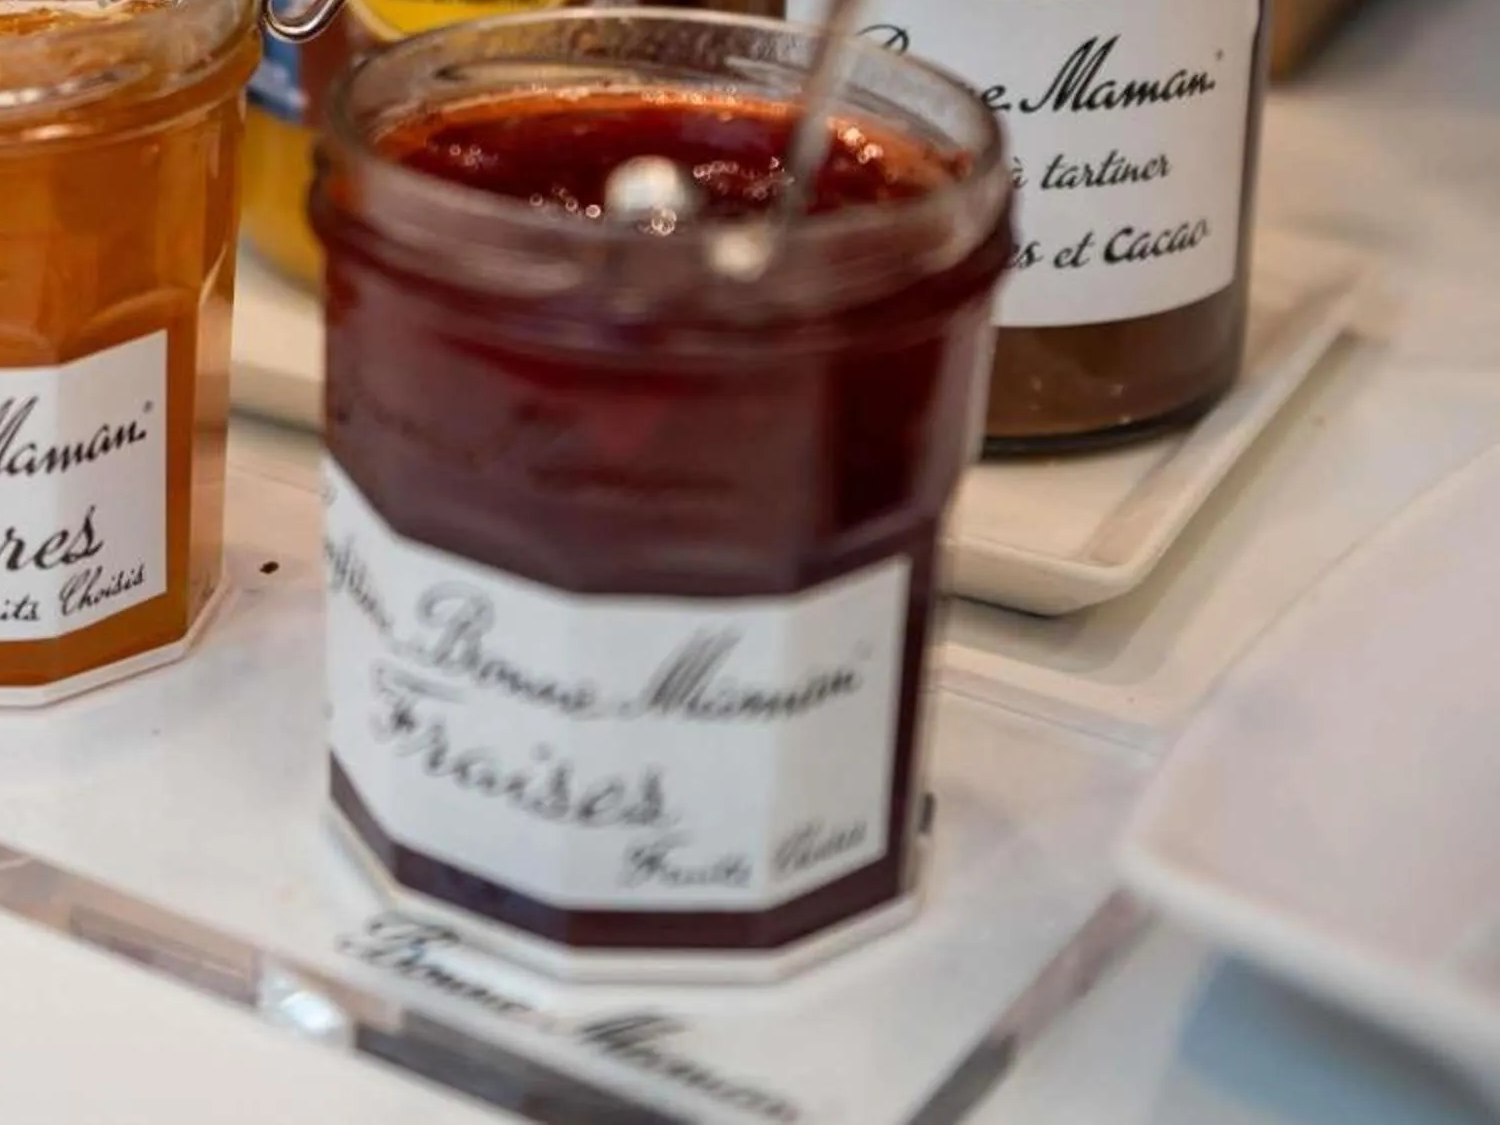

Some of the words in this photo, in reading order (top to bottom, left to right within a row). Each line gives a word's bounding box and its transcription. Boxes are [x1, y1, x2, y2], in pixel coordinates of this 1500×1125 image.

[1020, 34, 1216, 114] Maman
[1040, 148, 1172, 192] tartiner
[1053, 234, 1091, 270] et
[1103, 218, 1210, 265] Cacao
[58, 561, 146, 618] Choisis
